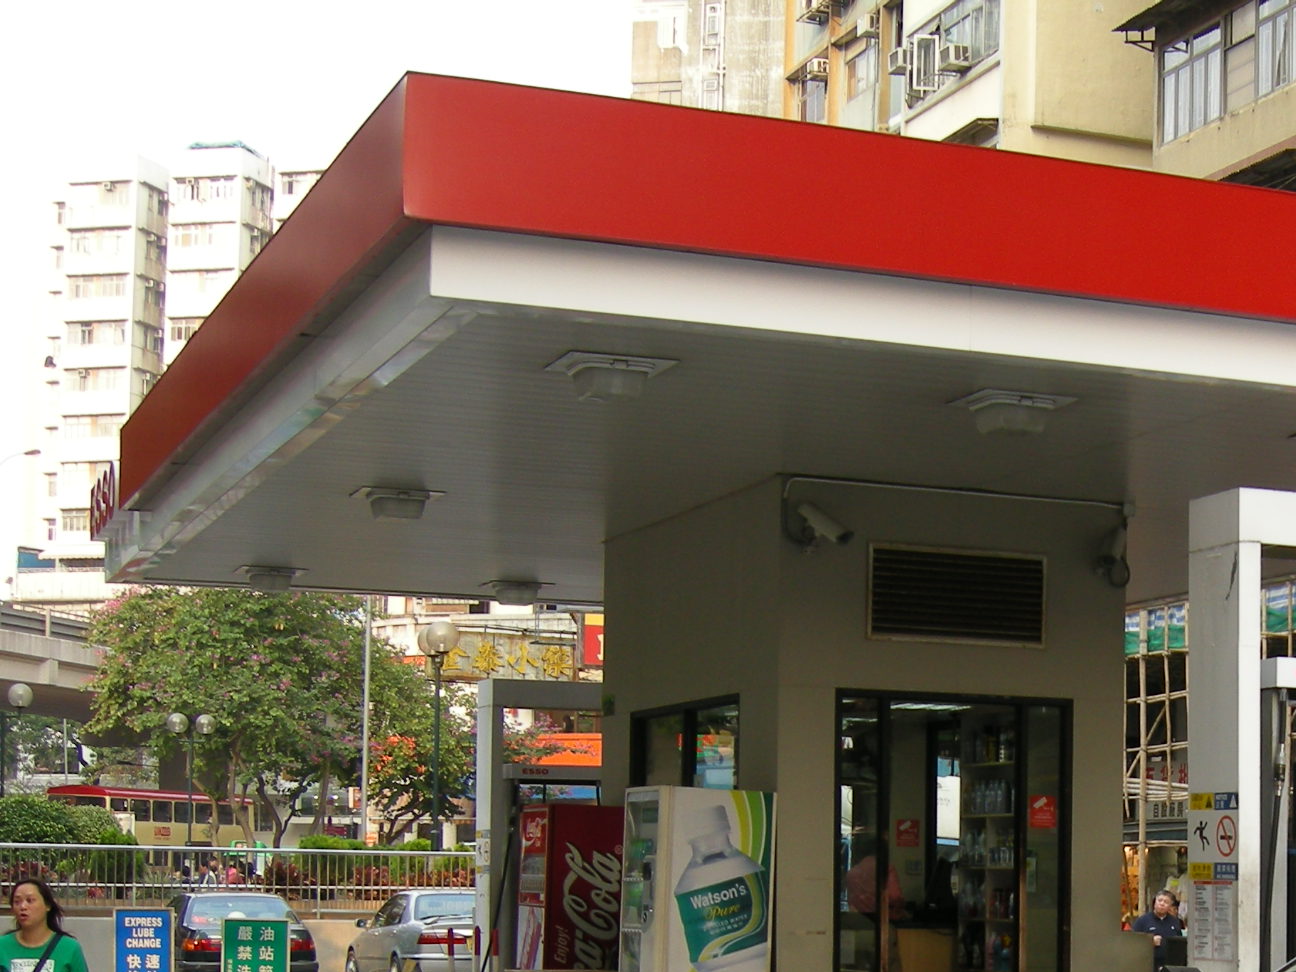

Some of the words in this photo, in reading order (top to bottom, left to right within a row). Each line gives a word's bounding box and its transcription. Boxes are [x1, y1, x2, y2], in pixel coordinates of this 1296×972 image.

[690, 883, 746, 909] Watson's
[705, 905, 739, 920] Pure
[124, 917, 162, 927] EXPRESS
[132, 928, 155, 937] LUBE
[126, 938, 161, 948] CHANGE
[554, 925, 569, 963] Enjoy!
[126, 954, 160, 969] 快速
